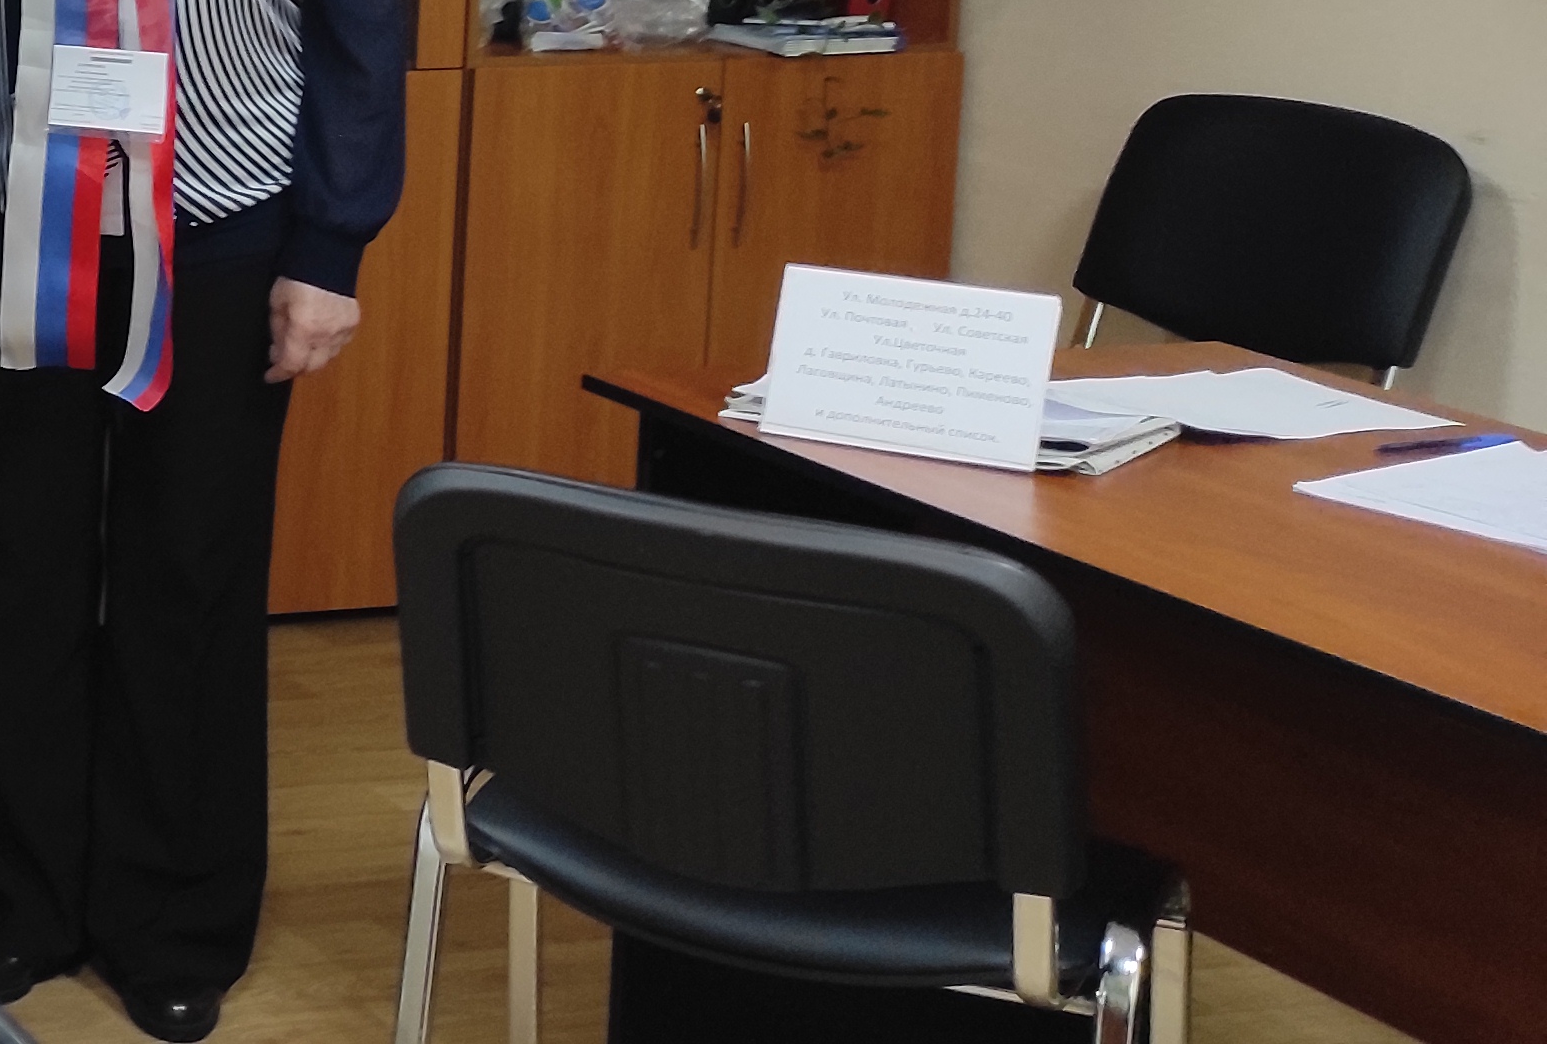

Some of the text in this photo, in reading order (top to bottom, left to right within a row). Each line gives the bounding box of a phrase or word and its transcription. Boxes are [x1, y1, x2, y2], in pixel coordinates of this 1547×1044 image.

[843, 291, 862, 302] Ул.
[866, 294, 957, 315] Молодежная
[821, 308, 839, 320] Ул.
[958, 326, 1029, 345] Советская
[821, 347, 903, 369] Гавриловка,
[876, 396, 944, 415] Андреево
[814, 408, 825, 417] и
[826, 408, 947, 436] дополнительный
